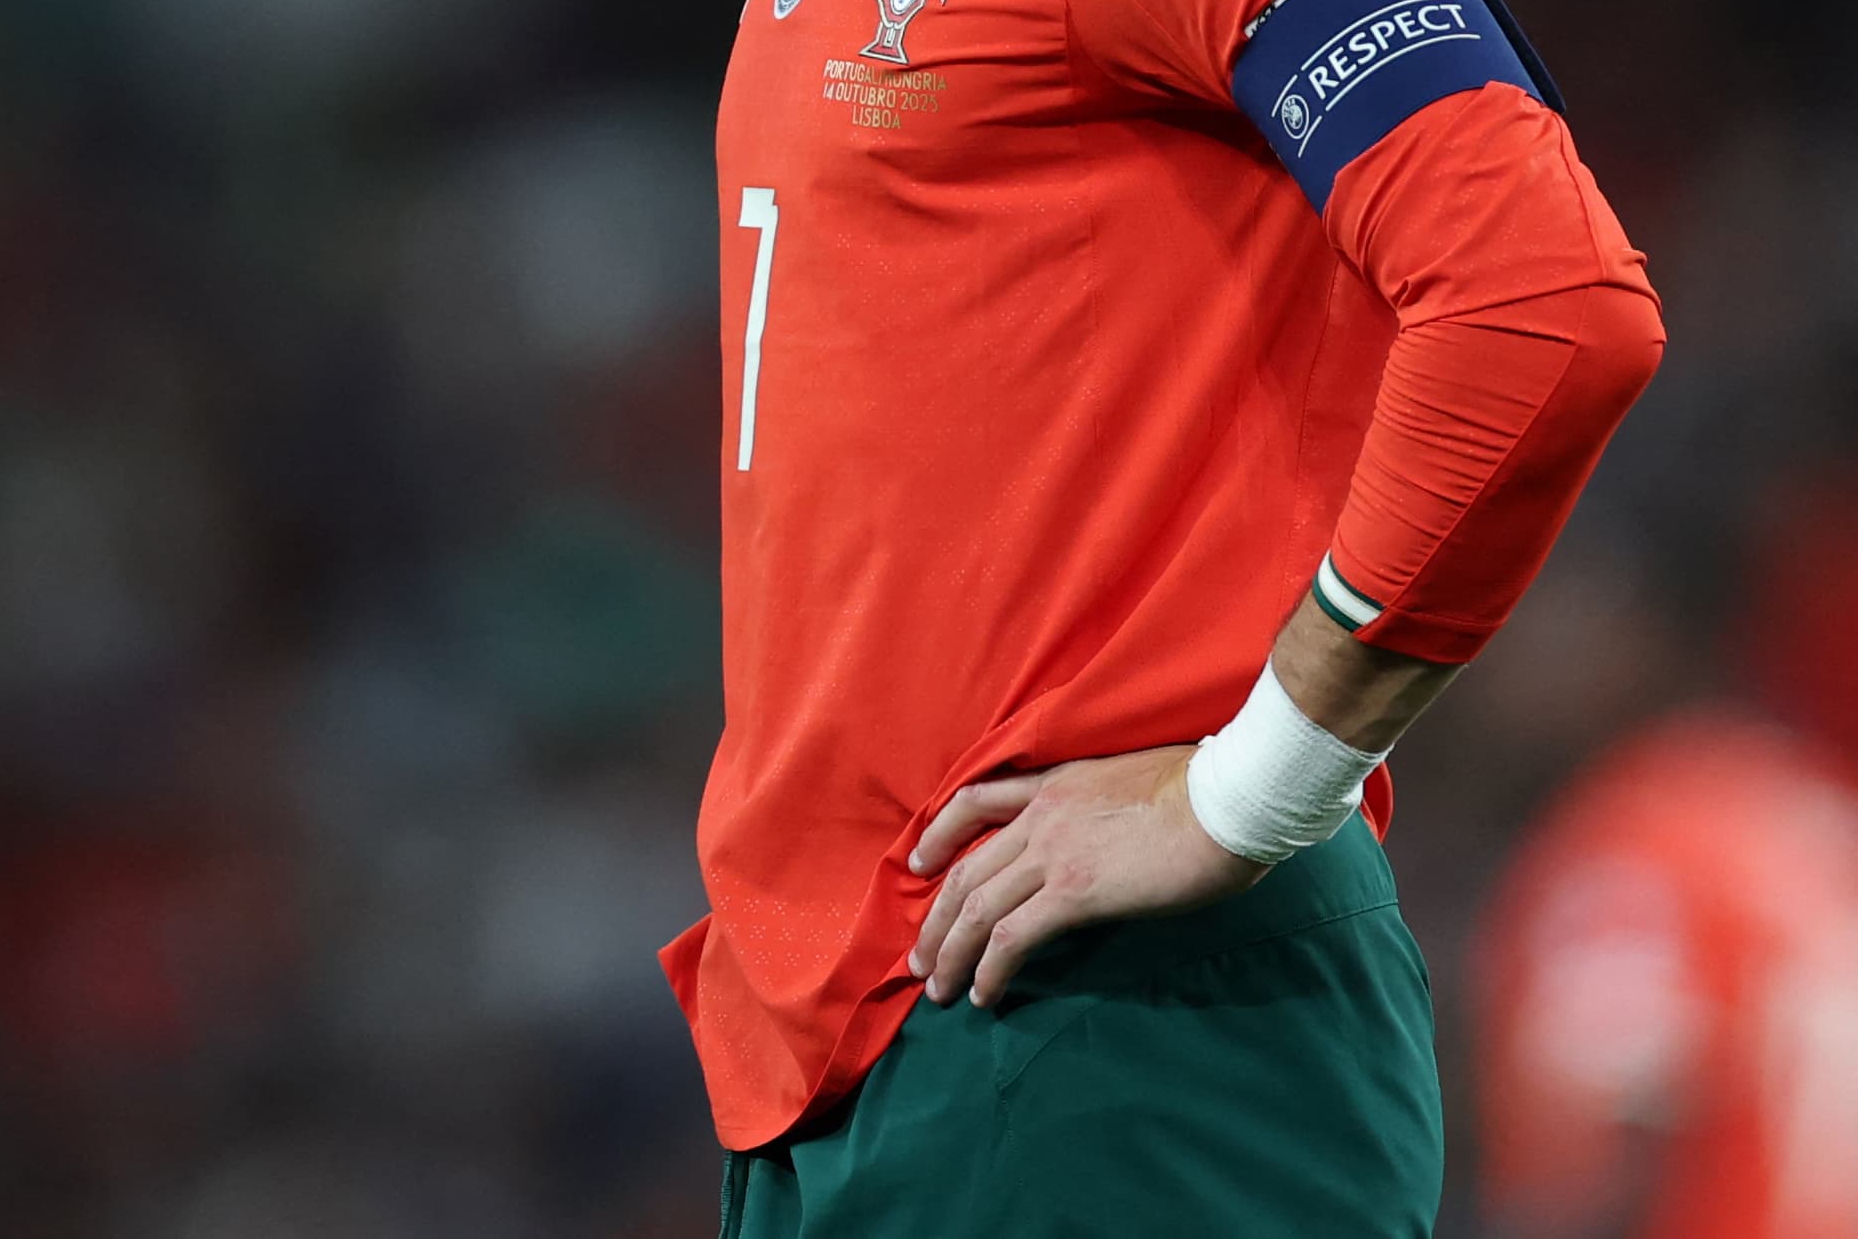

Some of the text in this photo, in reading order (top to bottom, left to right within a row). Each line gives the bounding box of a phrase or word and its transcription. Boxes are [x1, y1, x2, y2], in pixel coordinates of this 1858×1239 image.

[1308, 4, 1466, 100] RESPECT
[823, 81, 939, 113] 14 OUTUBRO 2025
[852, 105, 901, 129] LISBOA
[738, 186, 779, 471] 7
